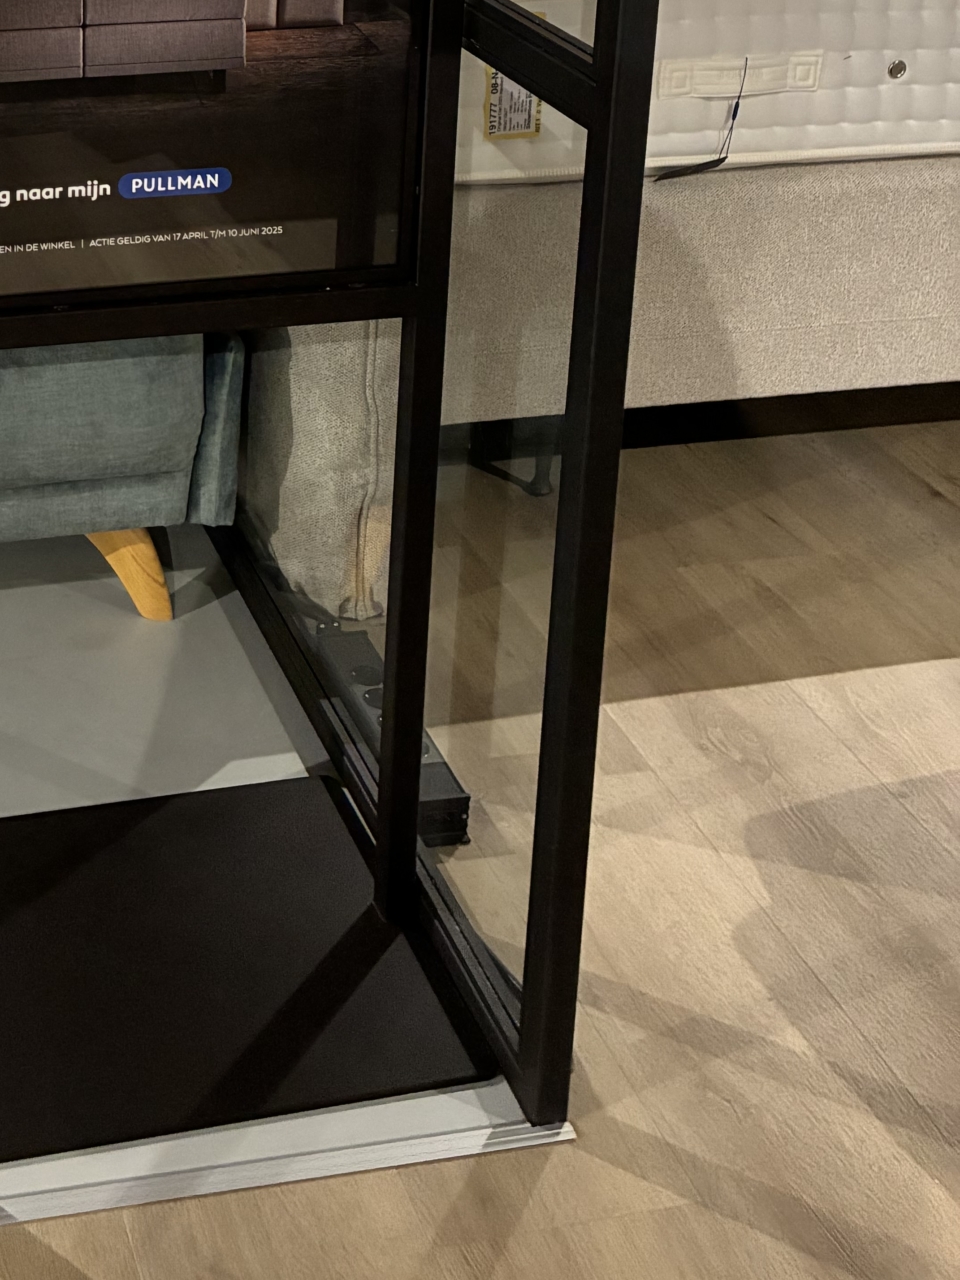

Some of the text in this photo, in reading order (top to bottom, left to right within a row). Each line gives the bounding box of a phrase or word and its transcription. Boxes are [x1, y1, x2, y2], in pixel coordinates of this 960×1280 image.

[15, 187, 64, 202] naar
[67, 180, 111, 201] mijn
[131, 173, 219, 193] PULLMAN
[13, 244, 24, 253] IN
[25, 243, 39, 252] DE
[40, 241, 76, 251] WINKEL
[89, 237, 116, 248] ACTIE
[117, 235, 151, 246] GELDIG
[152, 233, 171, 243] VAN
[173, 233, 181, 241] 17
[182, 230, 209, 240] APRIL
[210, 229, 227, 239] T/M
[227, 228, 238, 237] 10
[238, 227, 260, 237] JUNI
[261, 226, 283, 235] 2025
